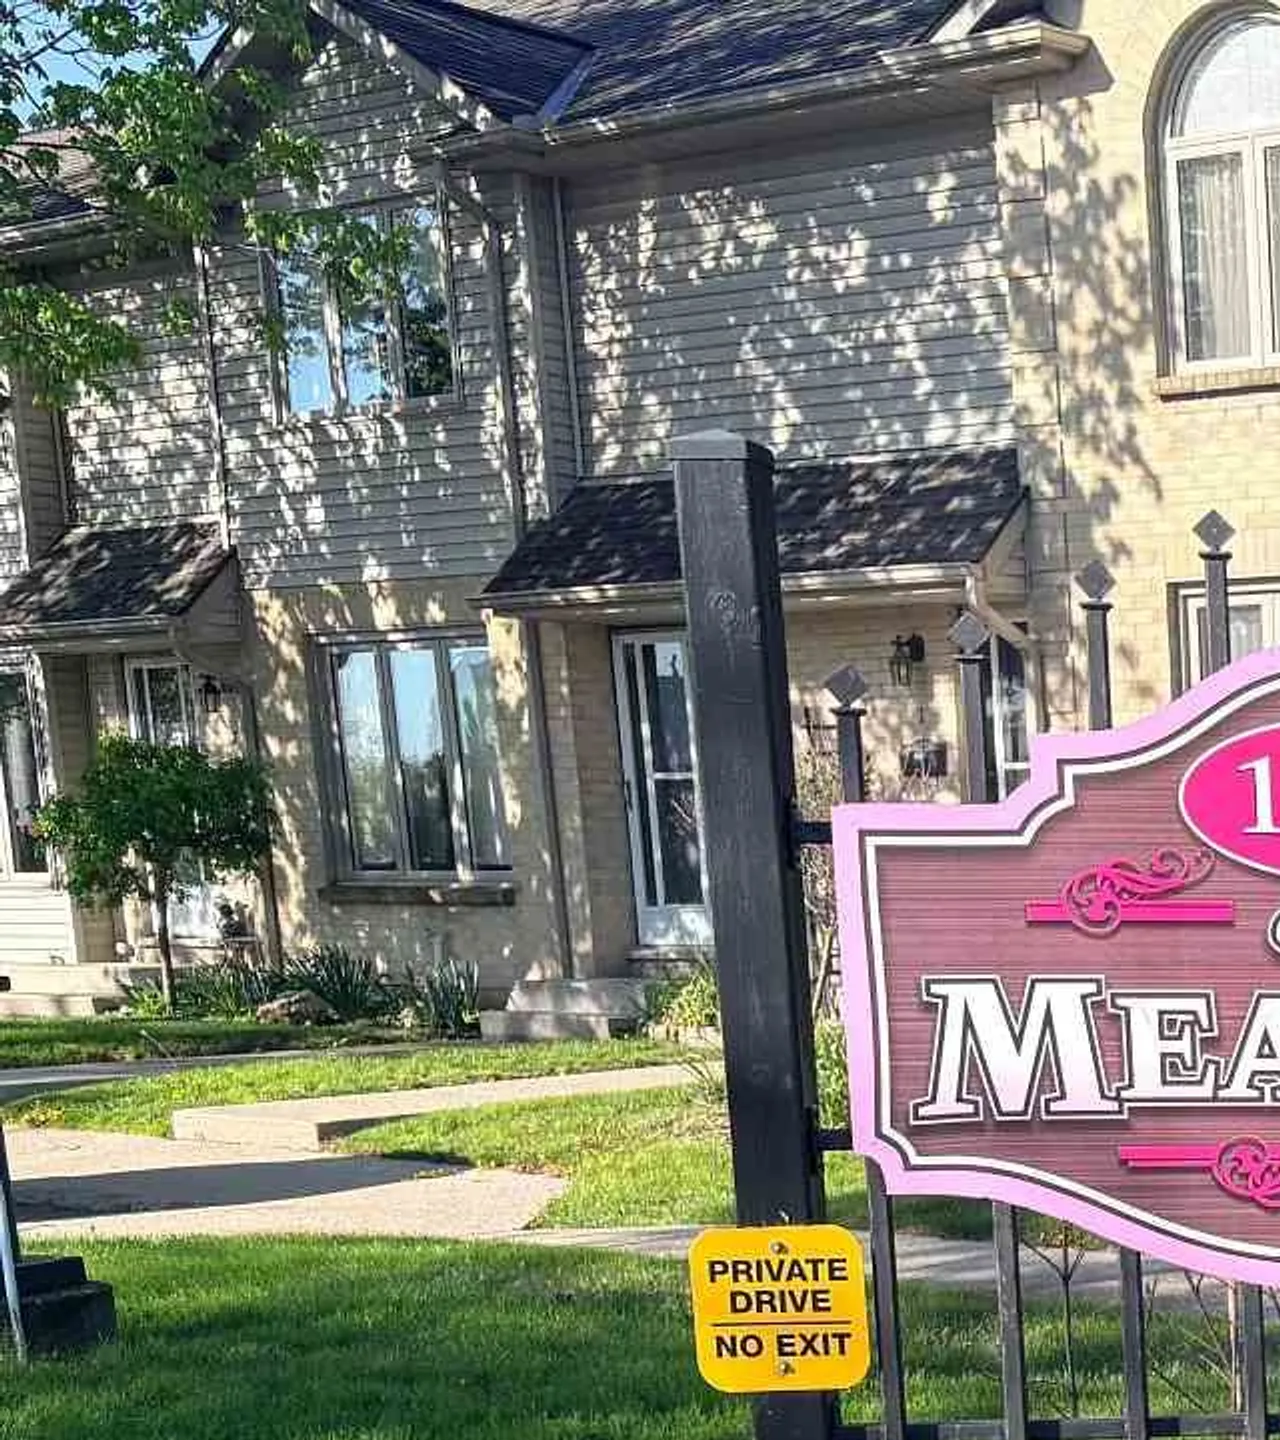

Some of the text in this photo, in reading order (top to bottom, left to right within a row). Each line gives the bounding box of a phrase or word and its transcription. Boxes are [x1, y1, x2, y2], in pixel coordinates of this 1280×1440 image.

[708, 1258, 848, 1283] PRIVATE
[729, 1289, 831, 1313] DRIVE
[716, 1332, 852, 1358] NO EXIT
